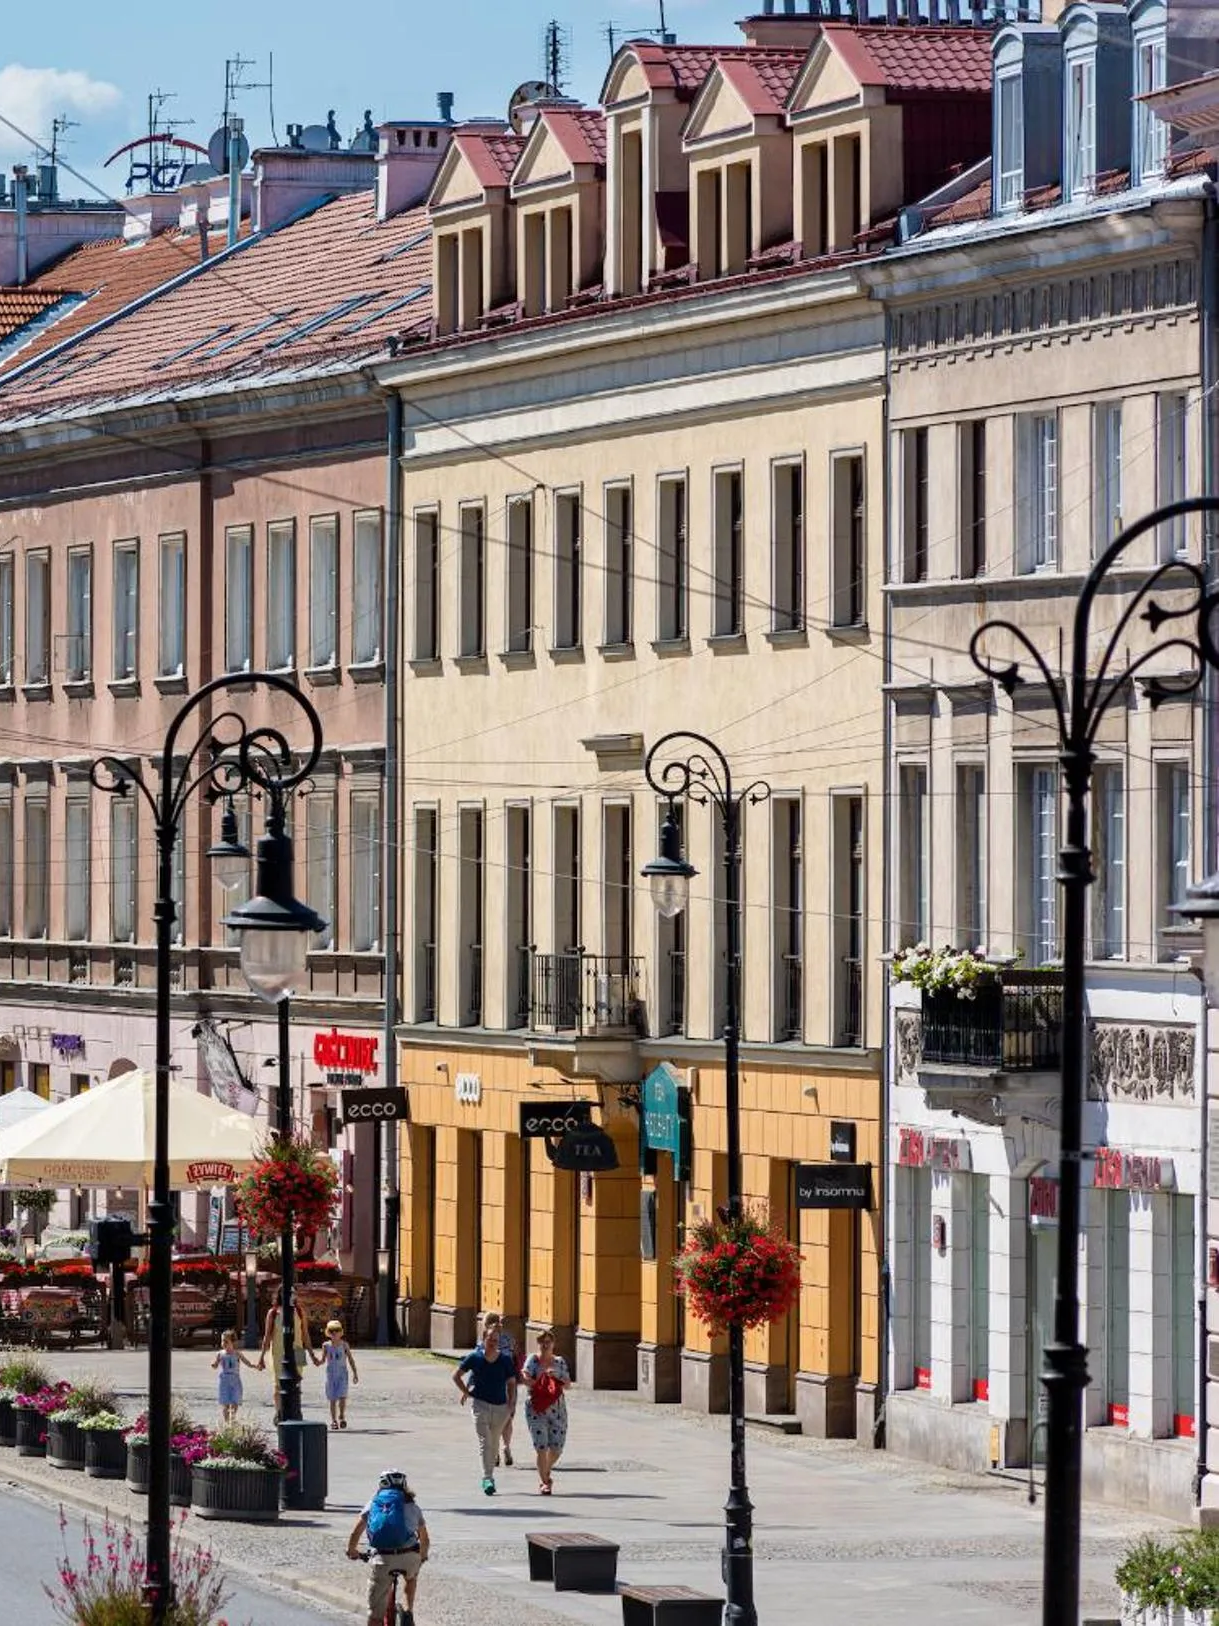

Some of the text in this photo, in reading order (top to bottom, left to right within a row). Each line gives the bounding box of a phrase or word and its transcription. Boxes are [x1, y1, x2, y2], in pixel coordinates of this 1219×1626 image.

[348, 1102, 397, 1118] ecco
[525, 1116, 579, 1132] ecco
[574, 1143, 602, 1157] TEA
[192, 1160, 231, 1177] ŻYWIEC
[799, 1187, 812, 1199] by
